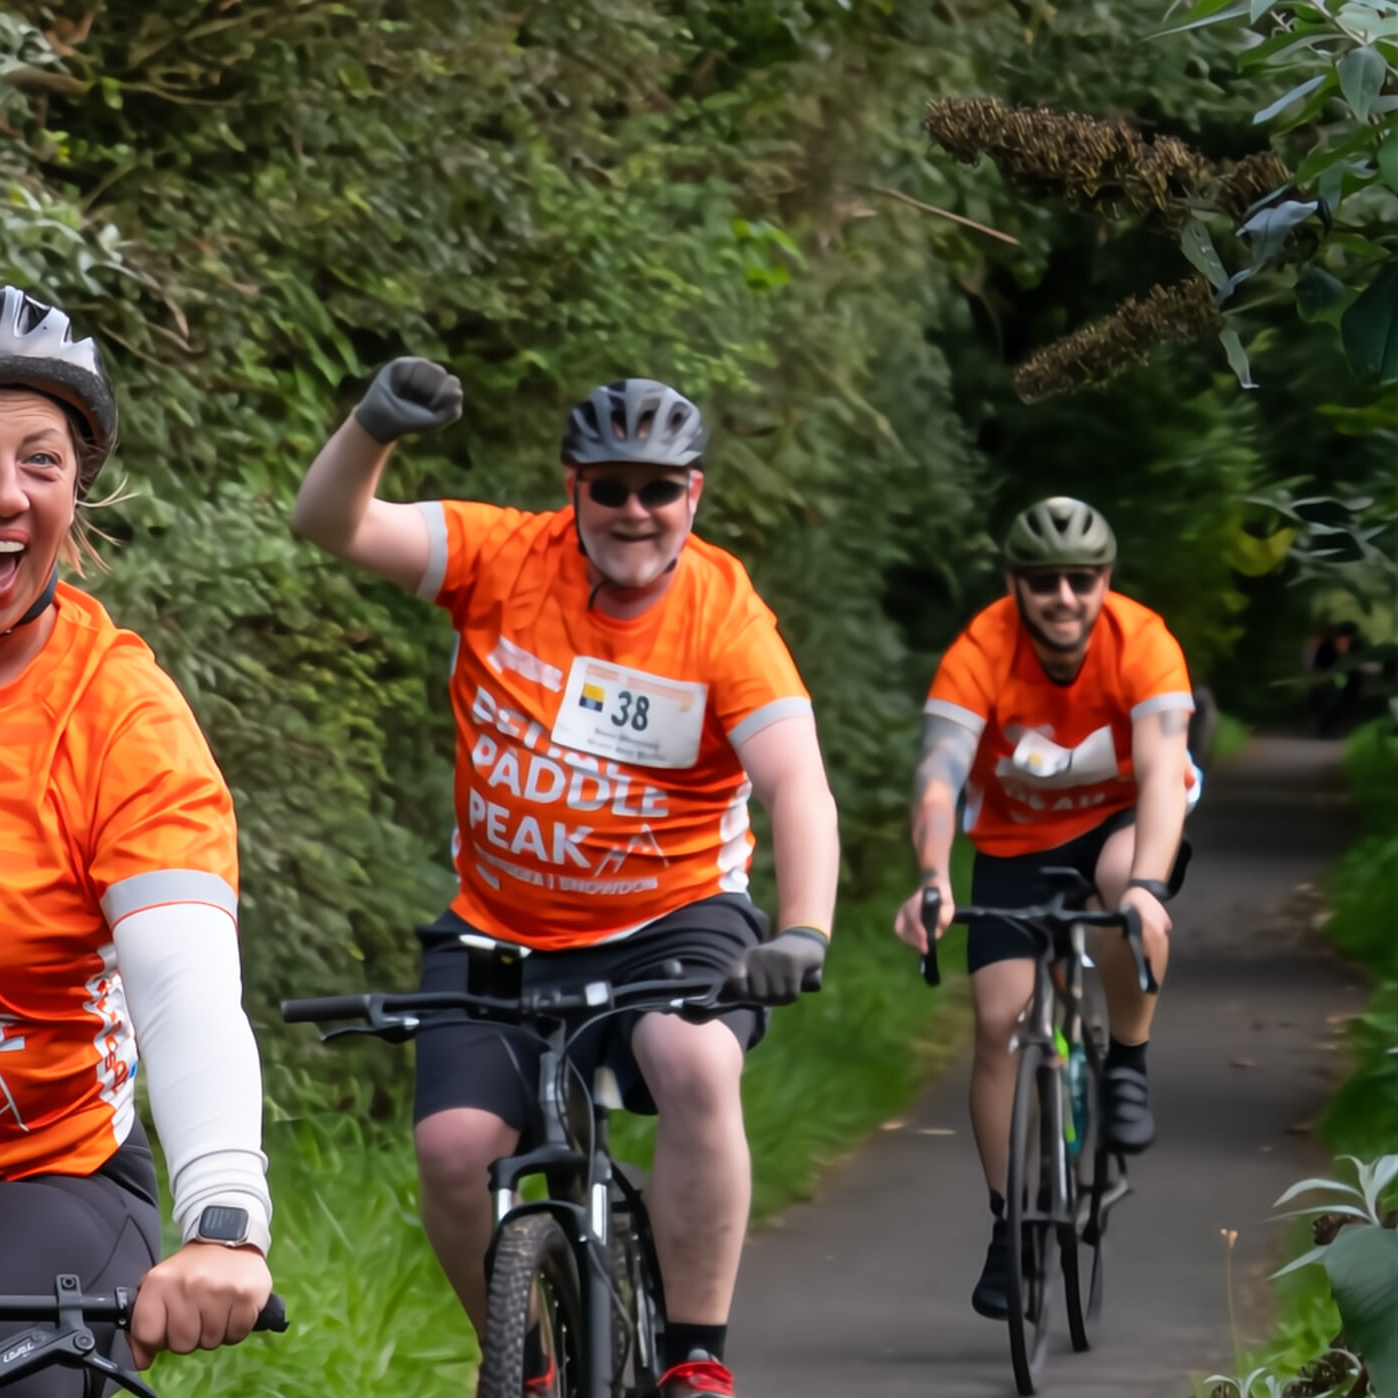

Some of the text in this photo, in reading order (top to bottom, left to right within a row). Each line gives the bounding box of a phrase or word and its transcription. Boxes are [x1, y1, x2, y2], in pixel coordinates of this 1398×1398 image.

[610, 690, 650, 731] 38
[472, 733, 669, 818] PADDLE
[469, 786, 595, 868] PEAK
